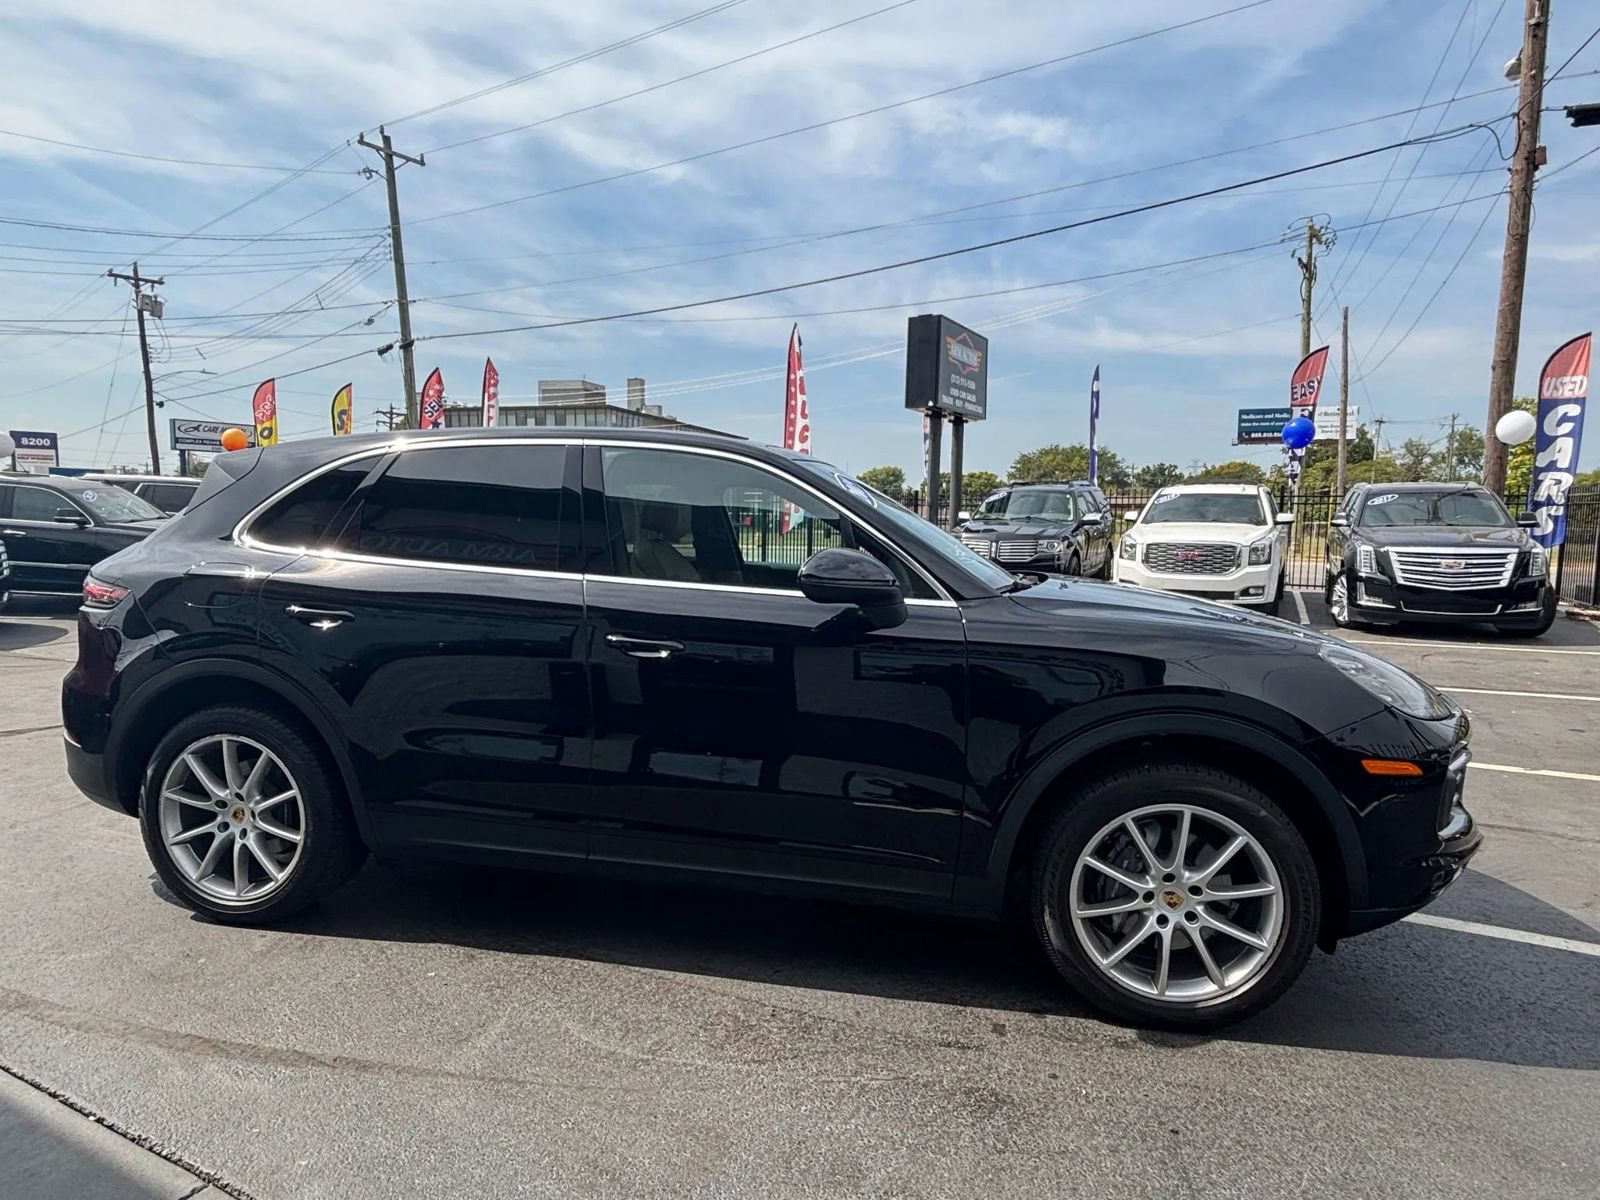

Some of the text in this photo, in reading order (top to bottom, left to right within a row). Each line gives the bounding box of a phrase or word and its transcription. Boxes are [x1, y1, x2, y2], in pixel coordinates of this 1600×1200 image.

[1543, 375, 1588, 397] USED
[202, 425, 219, 433] CARE
[21, 437, 51, 446] 8200
[1534, 403, 1582, 537] CARS
